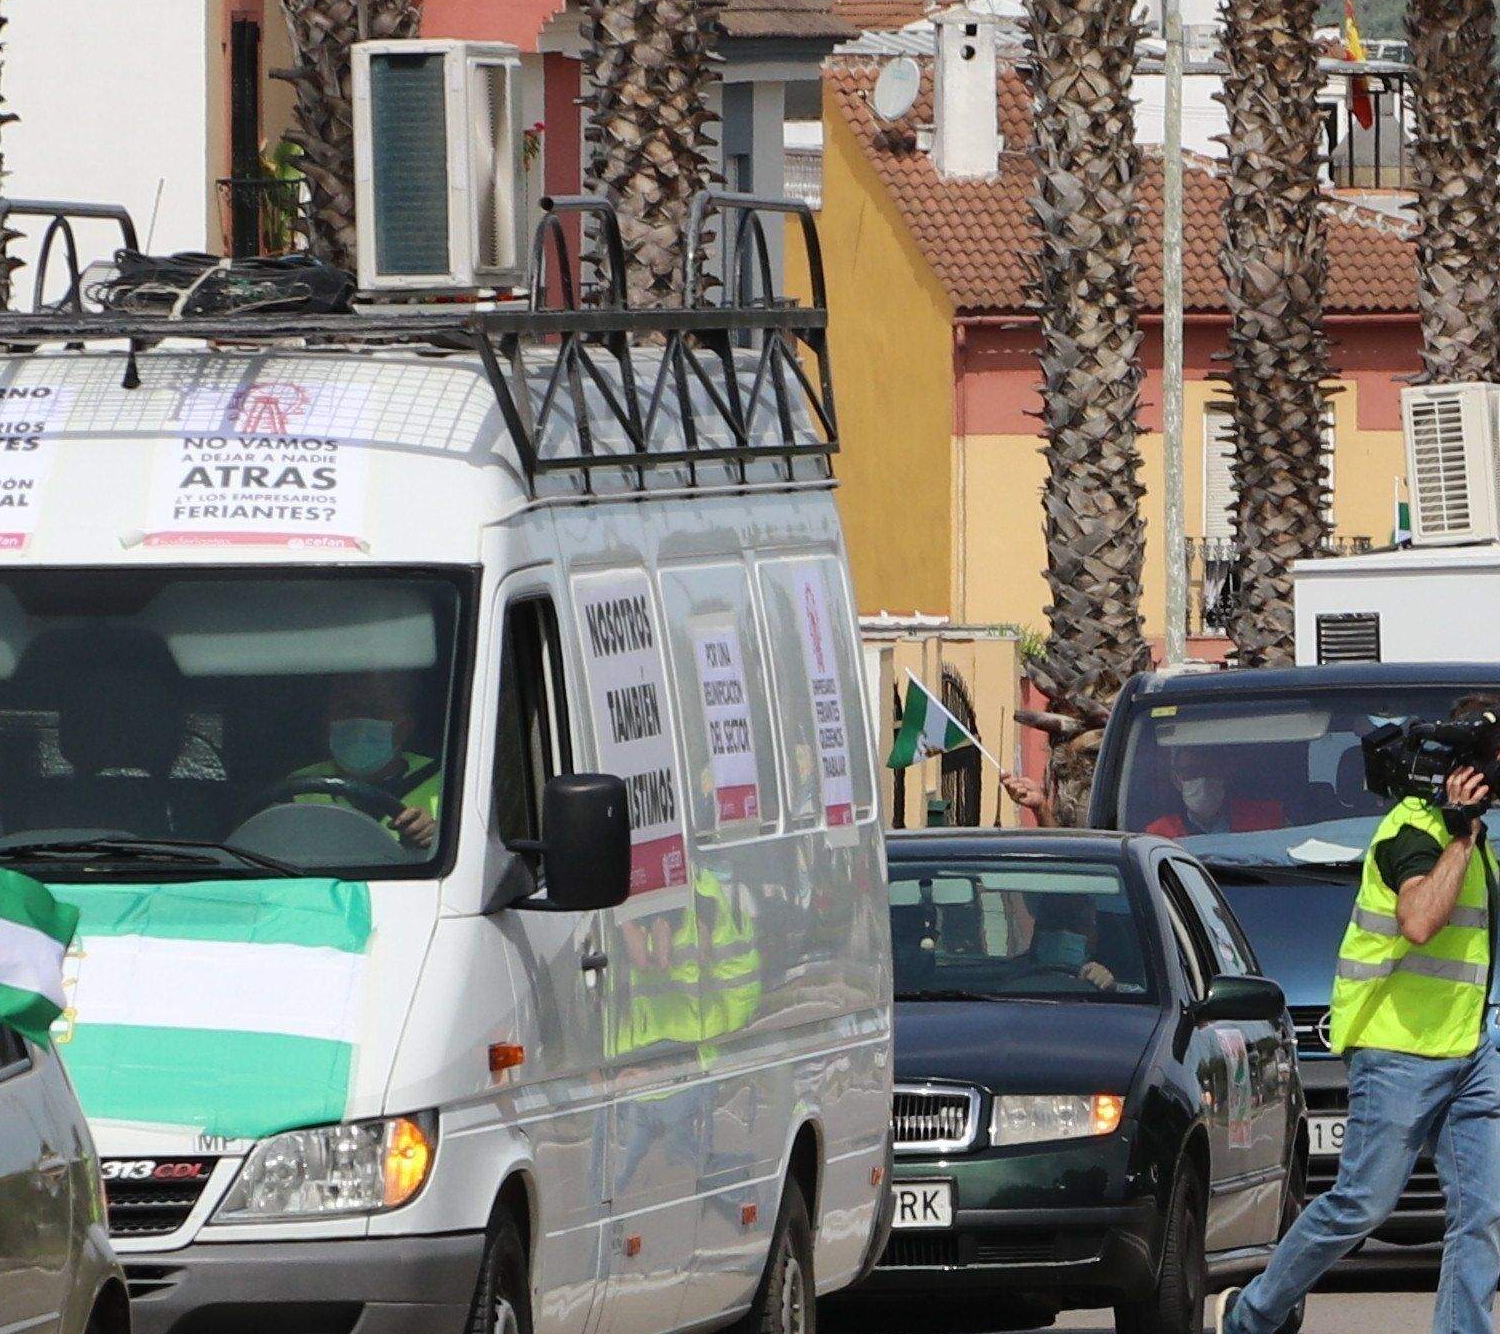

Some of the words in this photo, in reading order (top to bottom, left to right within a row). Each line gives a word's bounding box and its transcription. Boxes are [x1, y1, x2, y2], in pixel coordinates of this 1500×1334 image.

[183, 436, 228, 450] NO
[238, 437, 339, 452] VAMOS
[181, 453, 193, 463] A
[201, 453, 255, 463] DEJAR
[261, 453, 274, 463] A
[281, 453, 337, 464] NADIE
[179, 465, 338, 491] ATRAS
[175, 494, 192, 505] ¿Y
[199, 493, 227, 502] LOS
[232, 493, 337, 504] EMPRESARIOS
[173, 505, 337, 522] FERIANTES?
[585, 594, 653, 658] NOSOTROS
[606, 665, 662, 744] TAMBIÉN
[626, 767, 675, 831] ISTIMOS
[101, 1160, 156, 1180] 313
[153, 1163, 203, 1180] CDI
